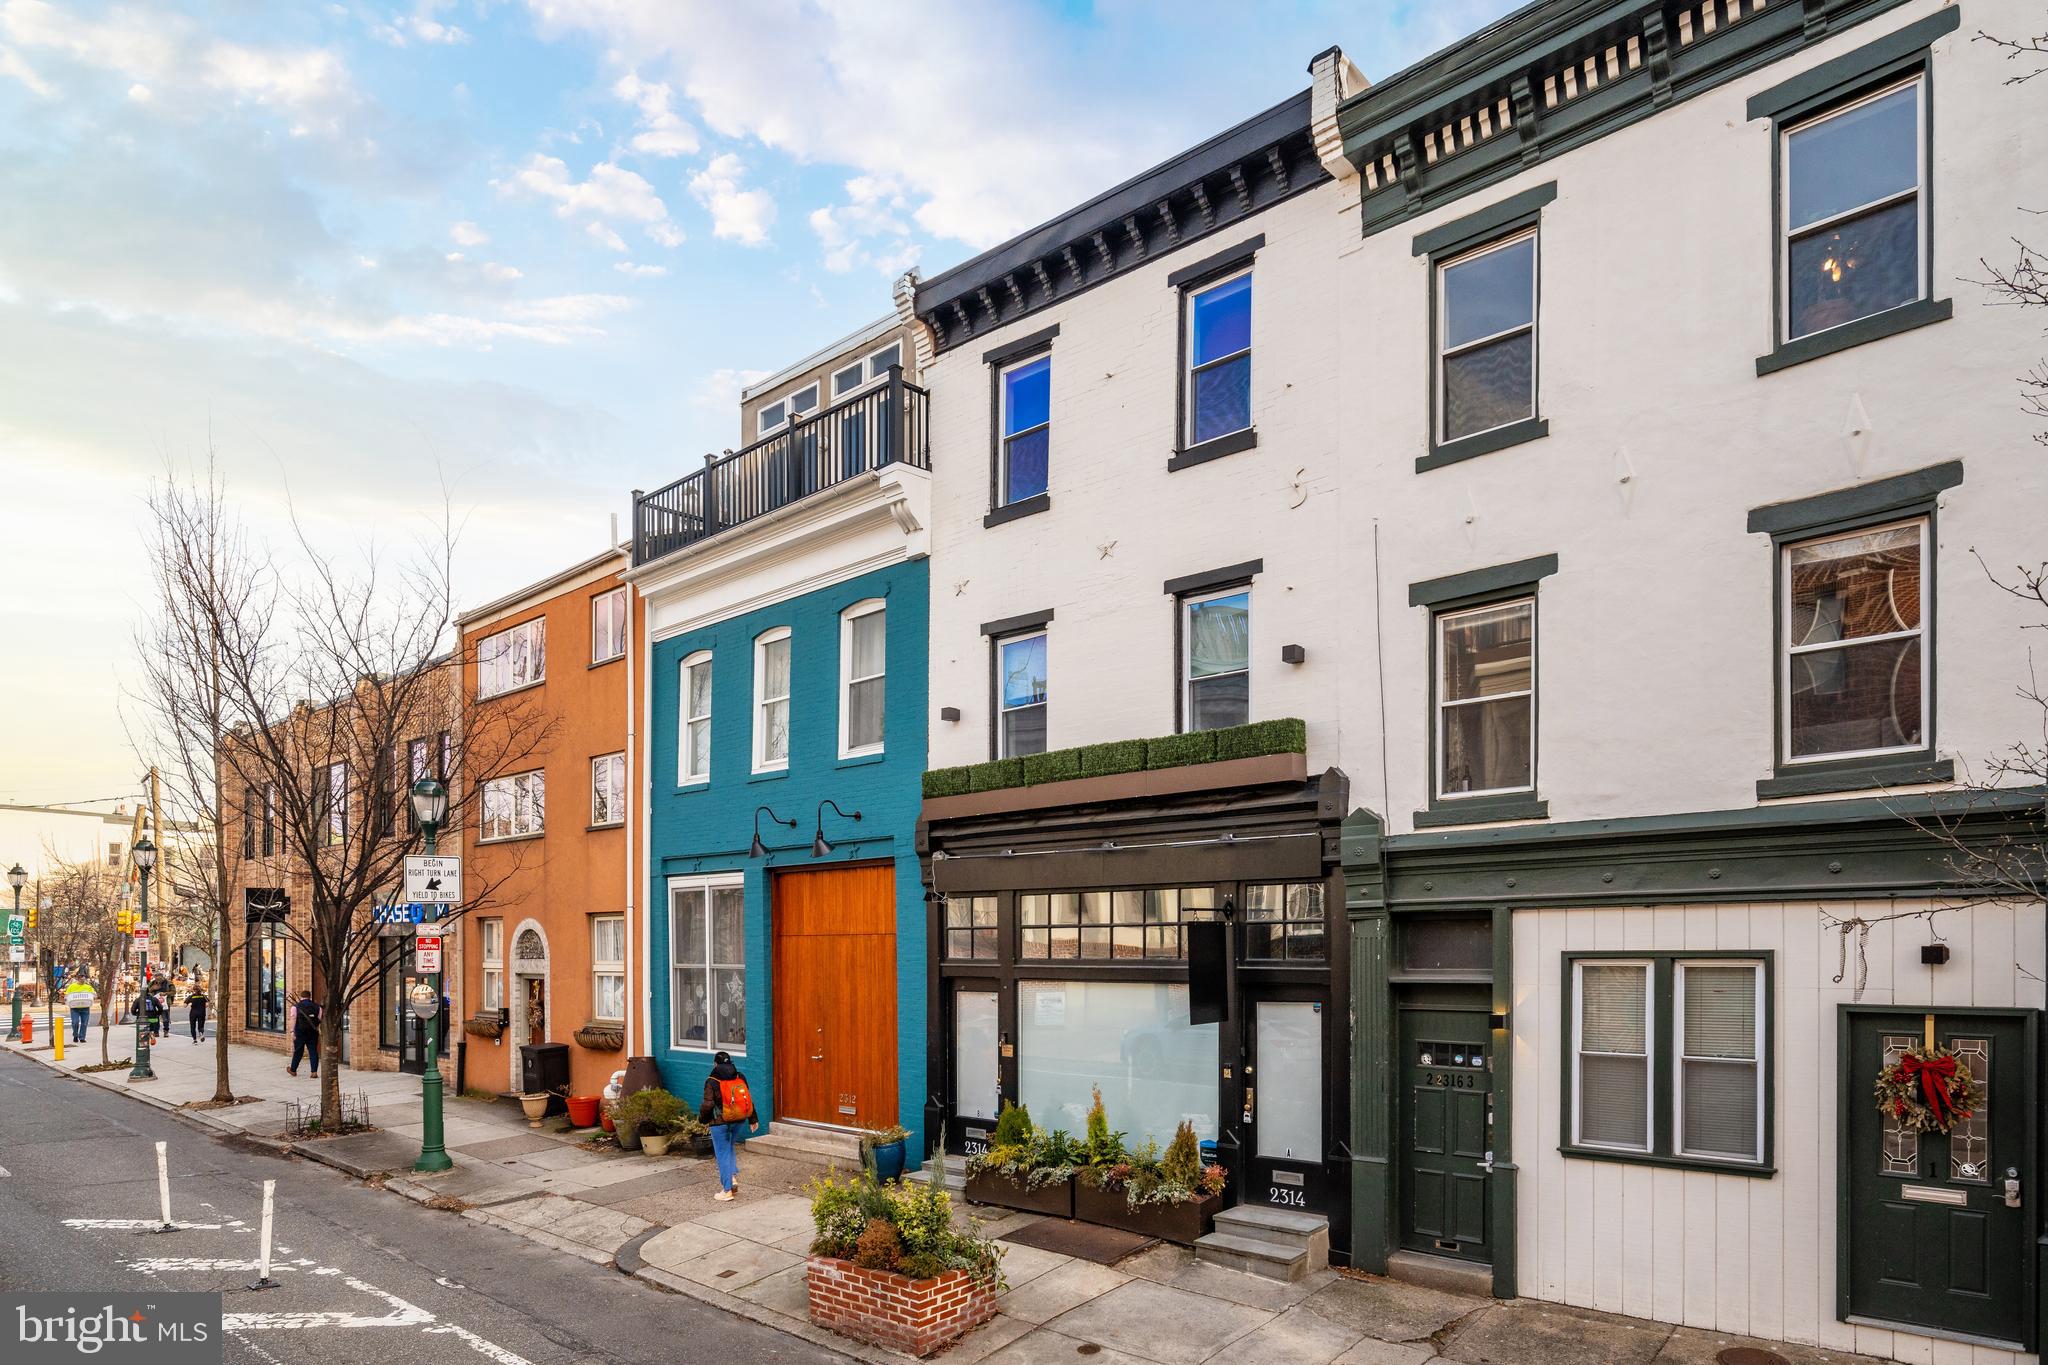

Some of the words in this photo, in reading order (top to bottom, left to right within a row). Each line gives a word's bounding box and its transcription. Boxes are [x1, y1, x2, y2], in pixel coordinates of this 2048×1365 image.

[423, 859, 443, 867] BEGIN
[427, 869, 441, 877] TURN
[413, 891, 428, 899] YIELD
[430, 891, 438, 899] TO
[372, 903, 410, 924] CHASE
[839, 1093, 856, 1104] 2312
[964, 1140, 988, 1155] 2314
[1286, 1148, 1292, 1158] A
[1929, 1162, 1938, 1178] 1
[1269, 1187, 1306, 1207] 2314
